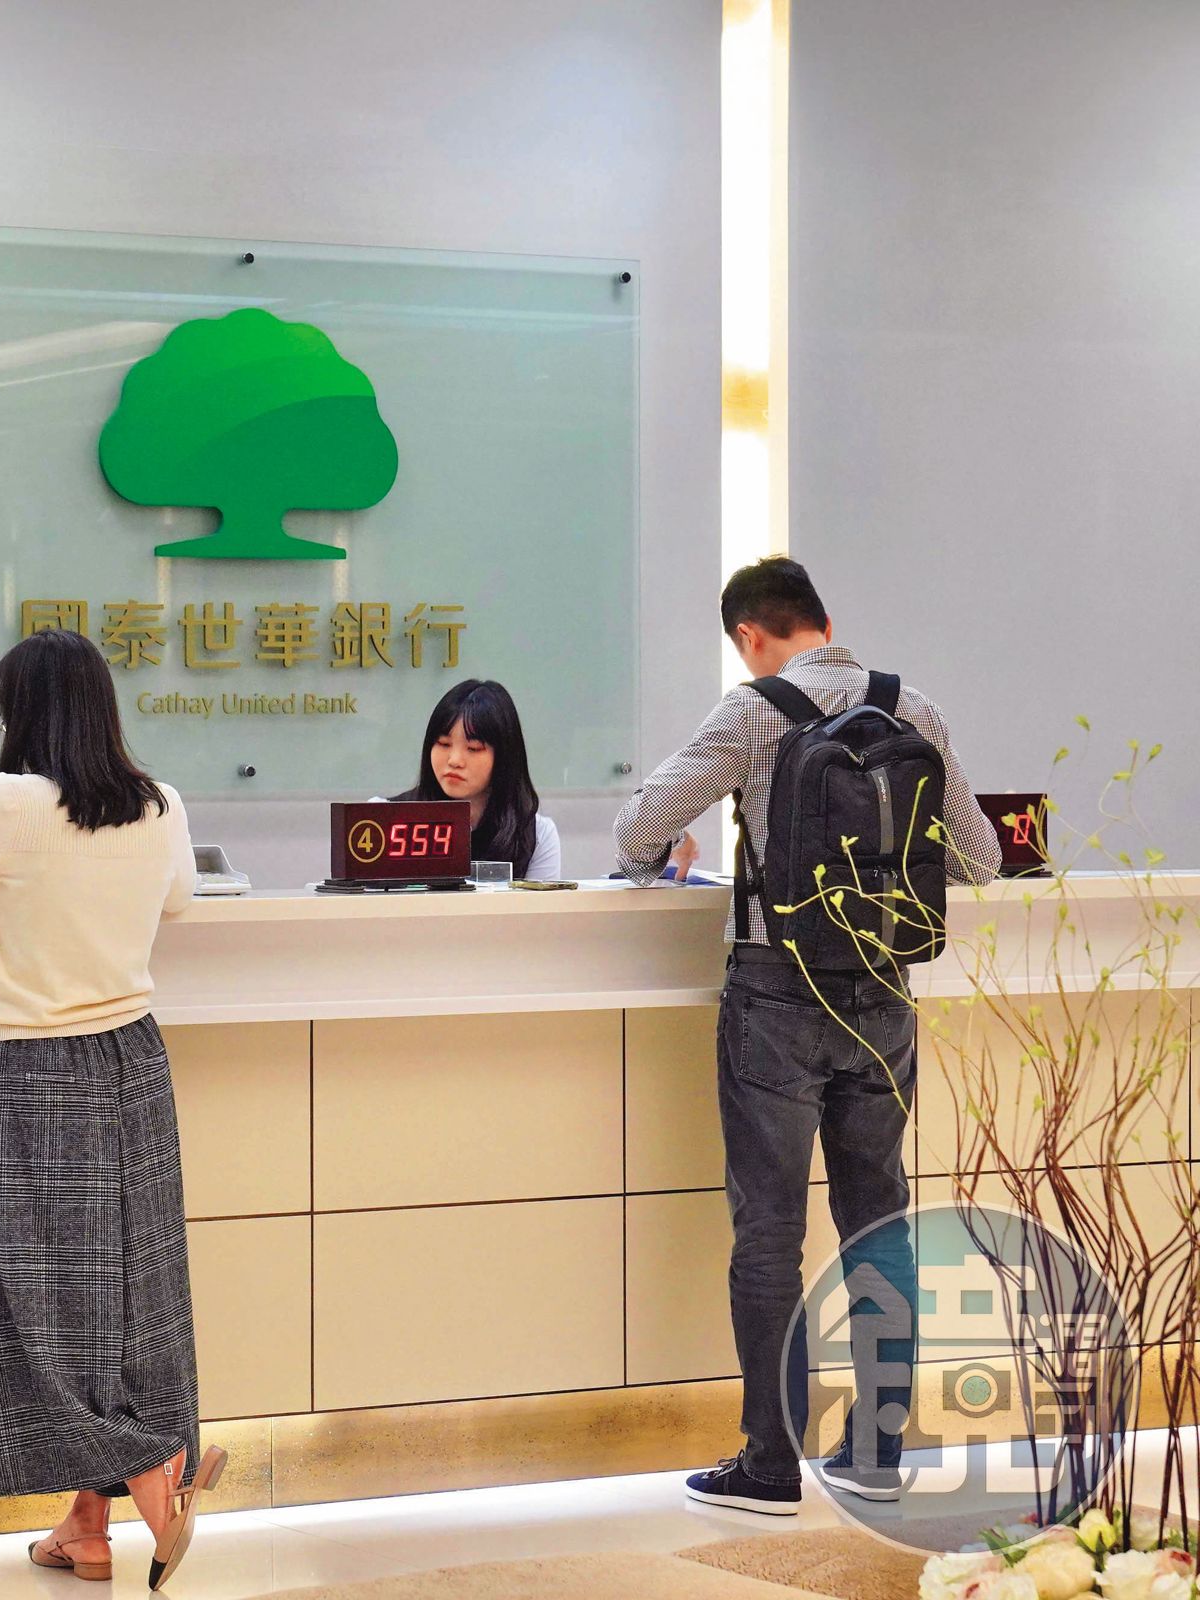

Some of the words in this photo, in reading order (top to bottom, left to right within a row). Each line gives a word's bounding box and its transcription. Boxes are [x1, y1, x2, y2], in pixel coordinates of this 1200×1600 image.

[137, 692, 214, 720] Cathay
[221, 692, 296, 715] United
[303, 692, 358, 715] Bank
[389, 824, 452, 857] 554
